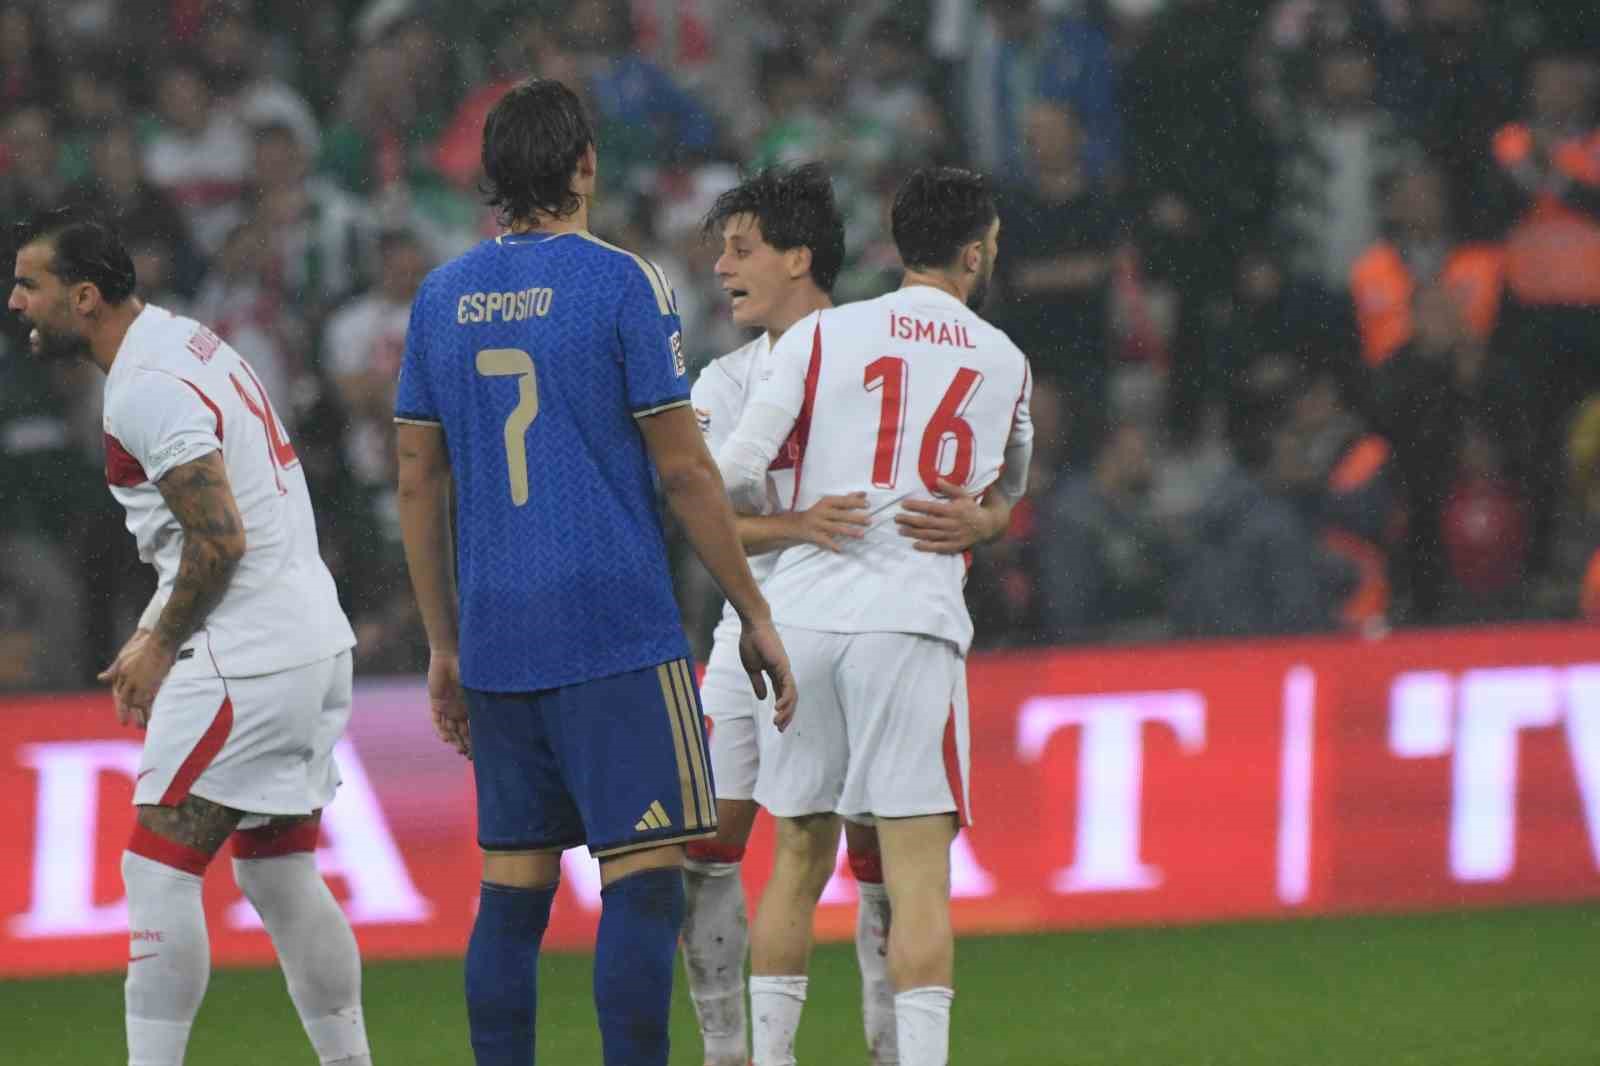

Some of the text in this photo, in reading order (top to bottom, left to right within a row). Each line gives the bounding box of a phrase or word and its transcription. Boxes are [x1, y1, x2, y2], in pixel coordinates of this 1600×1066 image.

[457, 287, 553, 325] ESPOSITO
[889, 310, 977, 349] İSMAİL
[475, 348, 539, 508] 7
[863, 355, 985, 499] 16
